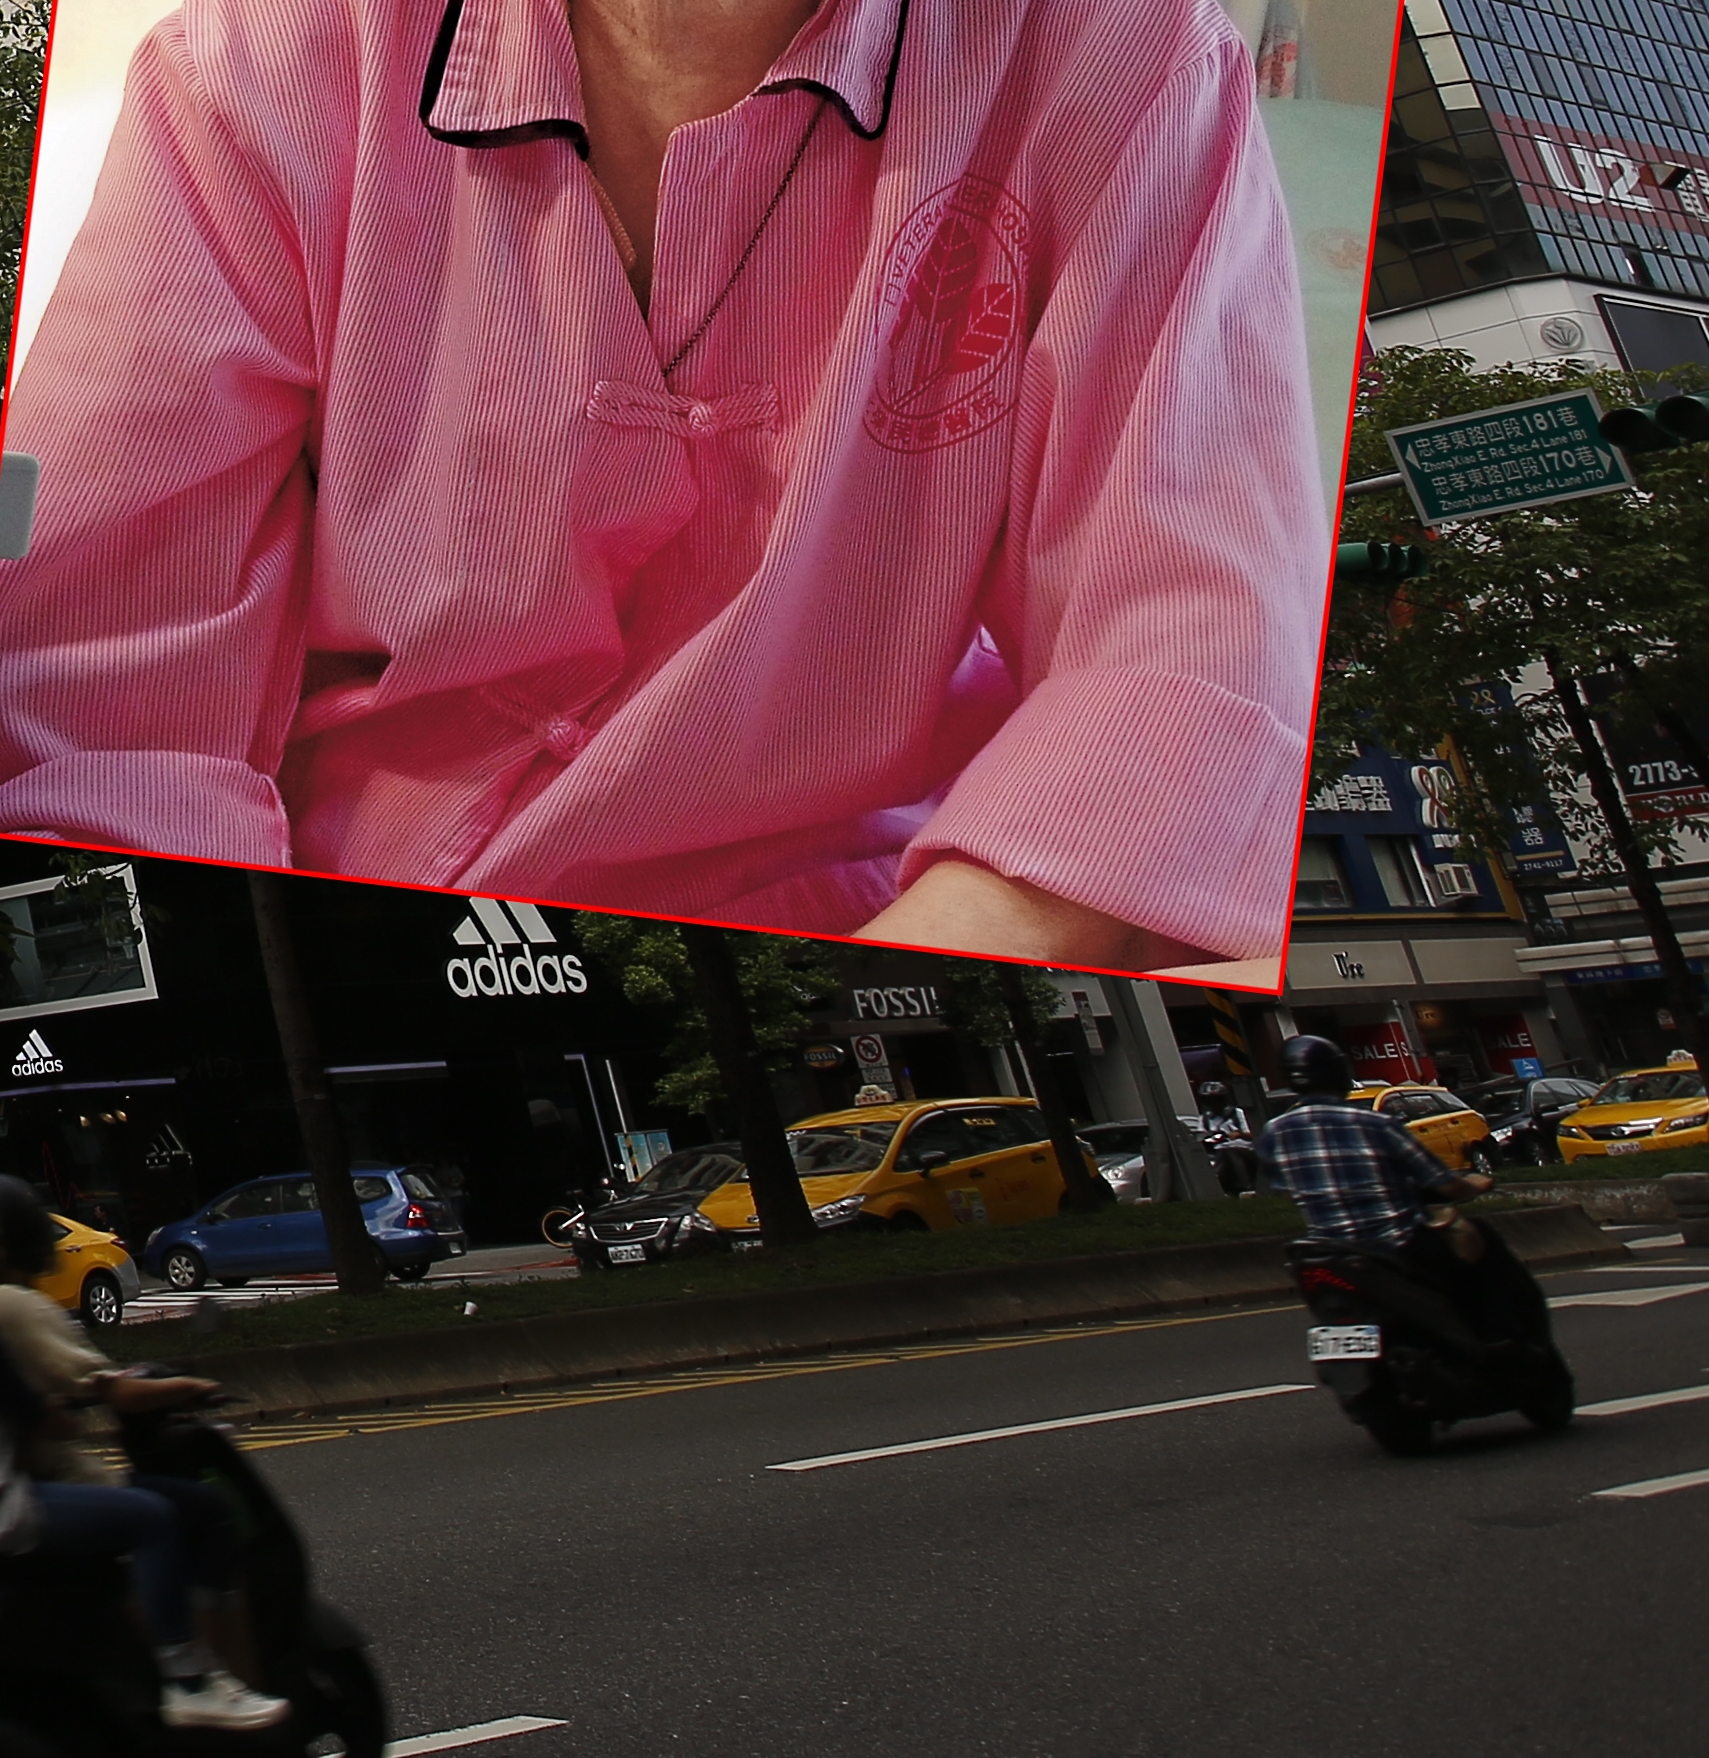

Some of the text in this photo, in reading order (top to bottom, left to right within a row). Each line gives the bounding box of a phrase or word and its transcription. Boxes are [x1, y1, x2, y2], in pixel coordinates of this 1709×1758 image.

[1533, 132, 1654, 212] U2
[1414, 405, 1579, 458] 忠孝東路四段181巷
[1421, 453, 1477, 473] ZhongXiao
[1542, 434, 1567, 448] Lane
[1567, 429, 1588, 442] 181
[1432, 445, 1597, 496] 忠孝東路四段170巷
[1439, 493, 1494, 512] ZhongXiao
[1554, 474, 1582, 489] Lane
[1584, 468, 1604, 483] 170
[446, 944, 588, 998] adidas
[803, 1051, 837, 1061] FOSSIL
[1351, 1042, 1396, 1060] SALE
[1488, 1031, 1531, 1050] SALE
[11, 1056, 64, 1077] adidas
